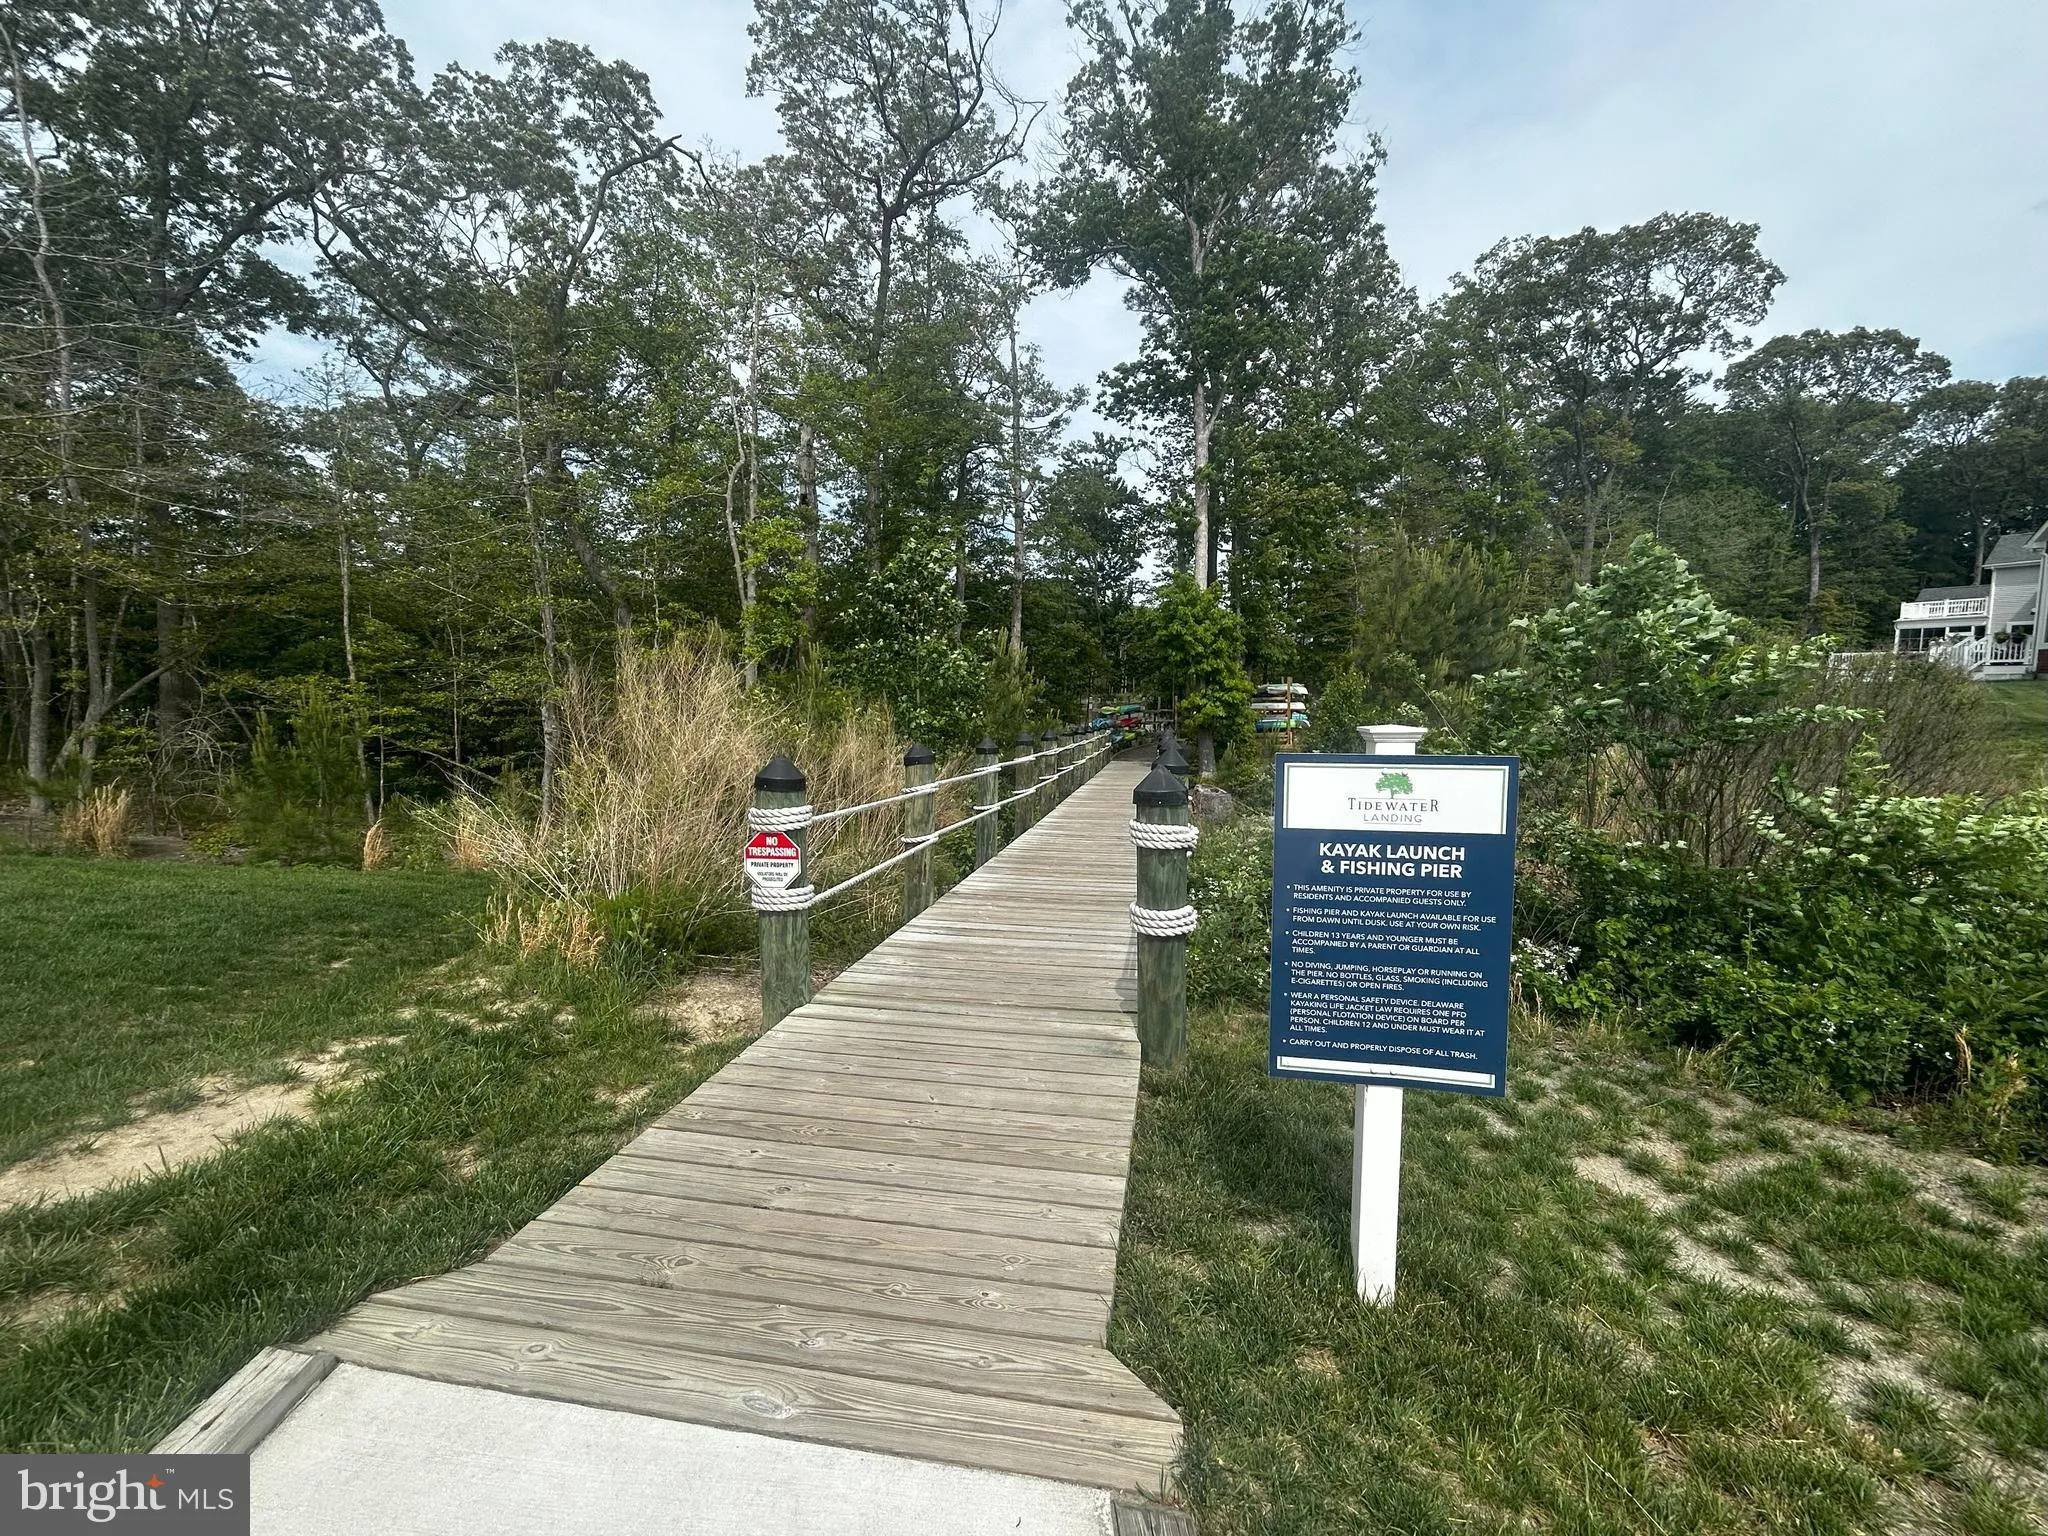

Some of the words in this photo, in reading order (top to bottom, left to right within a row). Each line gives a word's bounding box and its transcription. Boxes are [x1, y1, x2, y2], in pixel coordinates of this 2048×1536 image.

[1347, 797, 1439, 812] TIDEWATER
[1363, 813, 1422, 823] LANDING
[766, 837, 778, 846] NO
[748, 847, 796, 857] TRESPASSING
[1319, 842, 1382, 857] KAYAK
[1386, 844, 1464, 860] LAUNCH
[1320, 859, 1335, 873] &
[1340, 859, 1414, 876] FISHING
[1421, 863, 1462, 878] PIER
[1293, 892, 1333, 900] RESIDENTS
[1352, 895, 1409, 904] ACCOMPANIED
[1354, 886, 1384, 894] PRIVATE
[1386, 888, 1425, 896] PROPERTY
[1360, 910, 1384, 918] KAYAK
[1386, 911, 1418, 919] LAUNCH
[1419, 913, 1461, 921] AVAILABLE
[1342, 917, 1363, 925] UNTIL
[1416, 921, 1437, 929] YOUR
[1439, 922, 1460, 930] OWN
[1292, 930, 1329, 938] CHILDREN
[1341, 932, 1365, 940] YEARS
[1385, 935, 1423, 943] YOUNGER
[1292, 938, 1347, 947] ACCOMPANIED
[1368, 942, 1396, 950] PARENT
[1411, 945, 1452, 953] GUARDIAN
[1305, 961, 1332, 969] DIVING,
[1334, 963, 1370, 971] JUMPING,
[1372, 966, 1416, 974] HORSEPLAY
[1431, 969, 1467, 977] RUNNING
[1291, 977, 1344, 986] E-CIGARETTES)
[1359, 981, 1380, 989] OPEN
[1340, 972, 1373, 980] BOTTLES,
[1375, 974, 1401, 982] GLASS,
[1403, 976, 1439, 984] SMOKING
[1441, 978, 1487, 987] (INCLUDING
[1290, 991, 1312, 999] WEAR
[1320, 993, 1359, 1002] PERSONAL
[1361, 996, 1388, 1004] SAFETY
[1390, 998, 1419, 1006] DEVICE.
[1421, 1000, 1463, 1009] DELAWARE
[1290, 1000, 1327, 1008] KAYAKING
[1393, 1007, 1430, 1015] REQUIRES
[1290, 1008, 1330, 1016] (PERSONAL
[1332, 1011, 1373, 1019] FLOTATION
[1375, 1014, 1405, 1022] DEVICE)
[1420, 1017, 1448, 1025] BOARD
[1290, 1016, 1321, 1024] PERSON.
[1322, 1018, 1360, 1027] CHILDREN
[1390, 1023, 1417, 1031] UNDER
[1419, 1025, 1440, 1033] MUST
[1289, 1038, 1313, 1046] CARRY
[1331, 1041, 1348, 1049] AND
[1350, 1043, 1387, 1052] PROPERLY
[1389, 1046, 1420, 1054] DISPOSE
[1434, 1049, 1448, 1057] ALL
[1450, 1050, 1477, 1059] TRASH.
